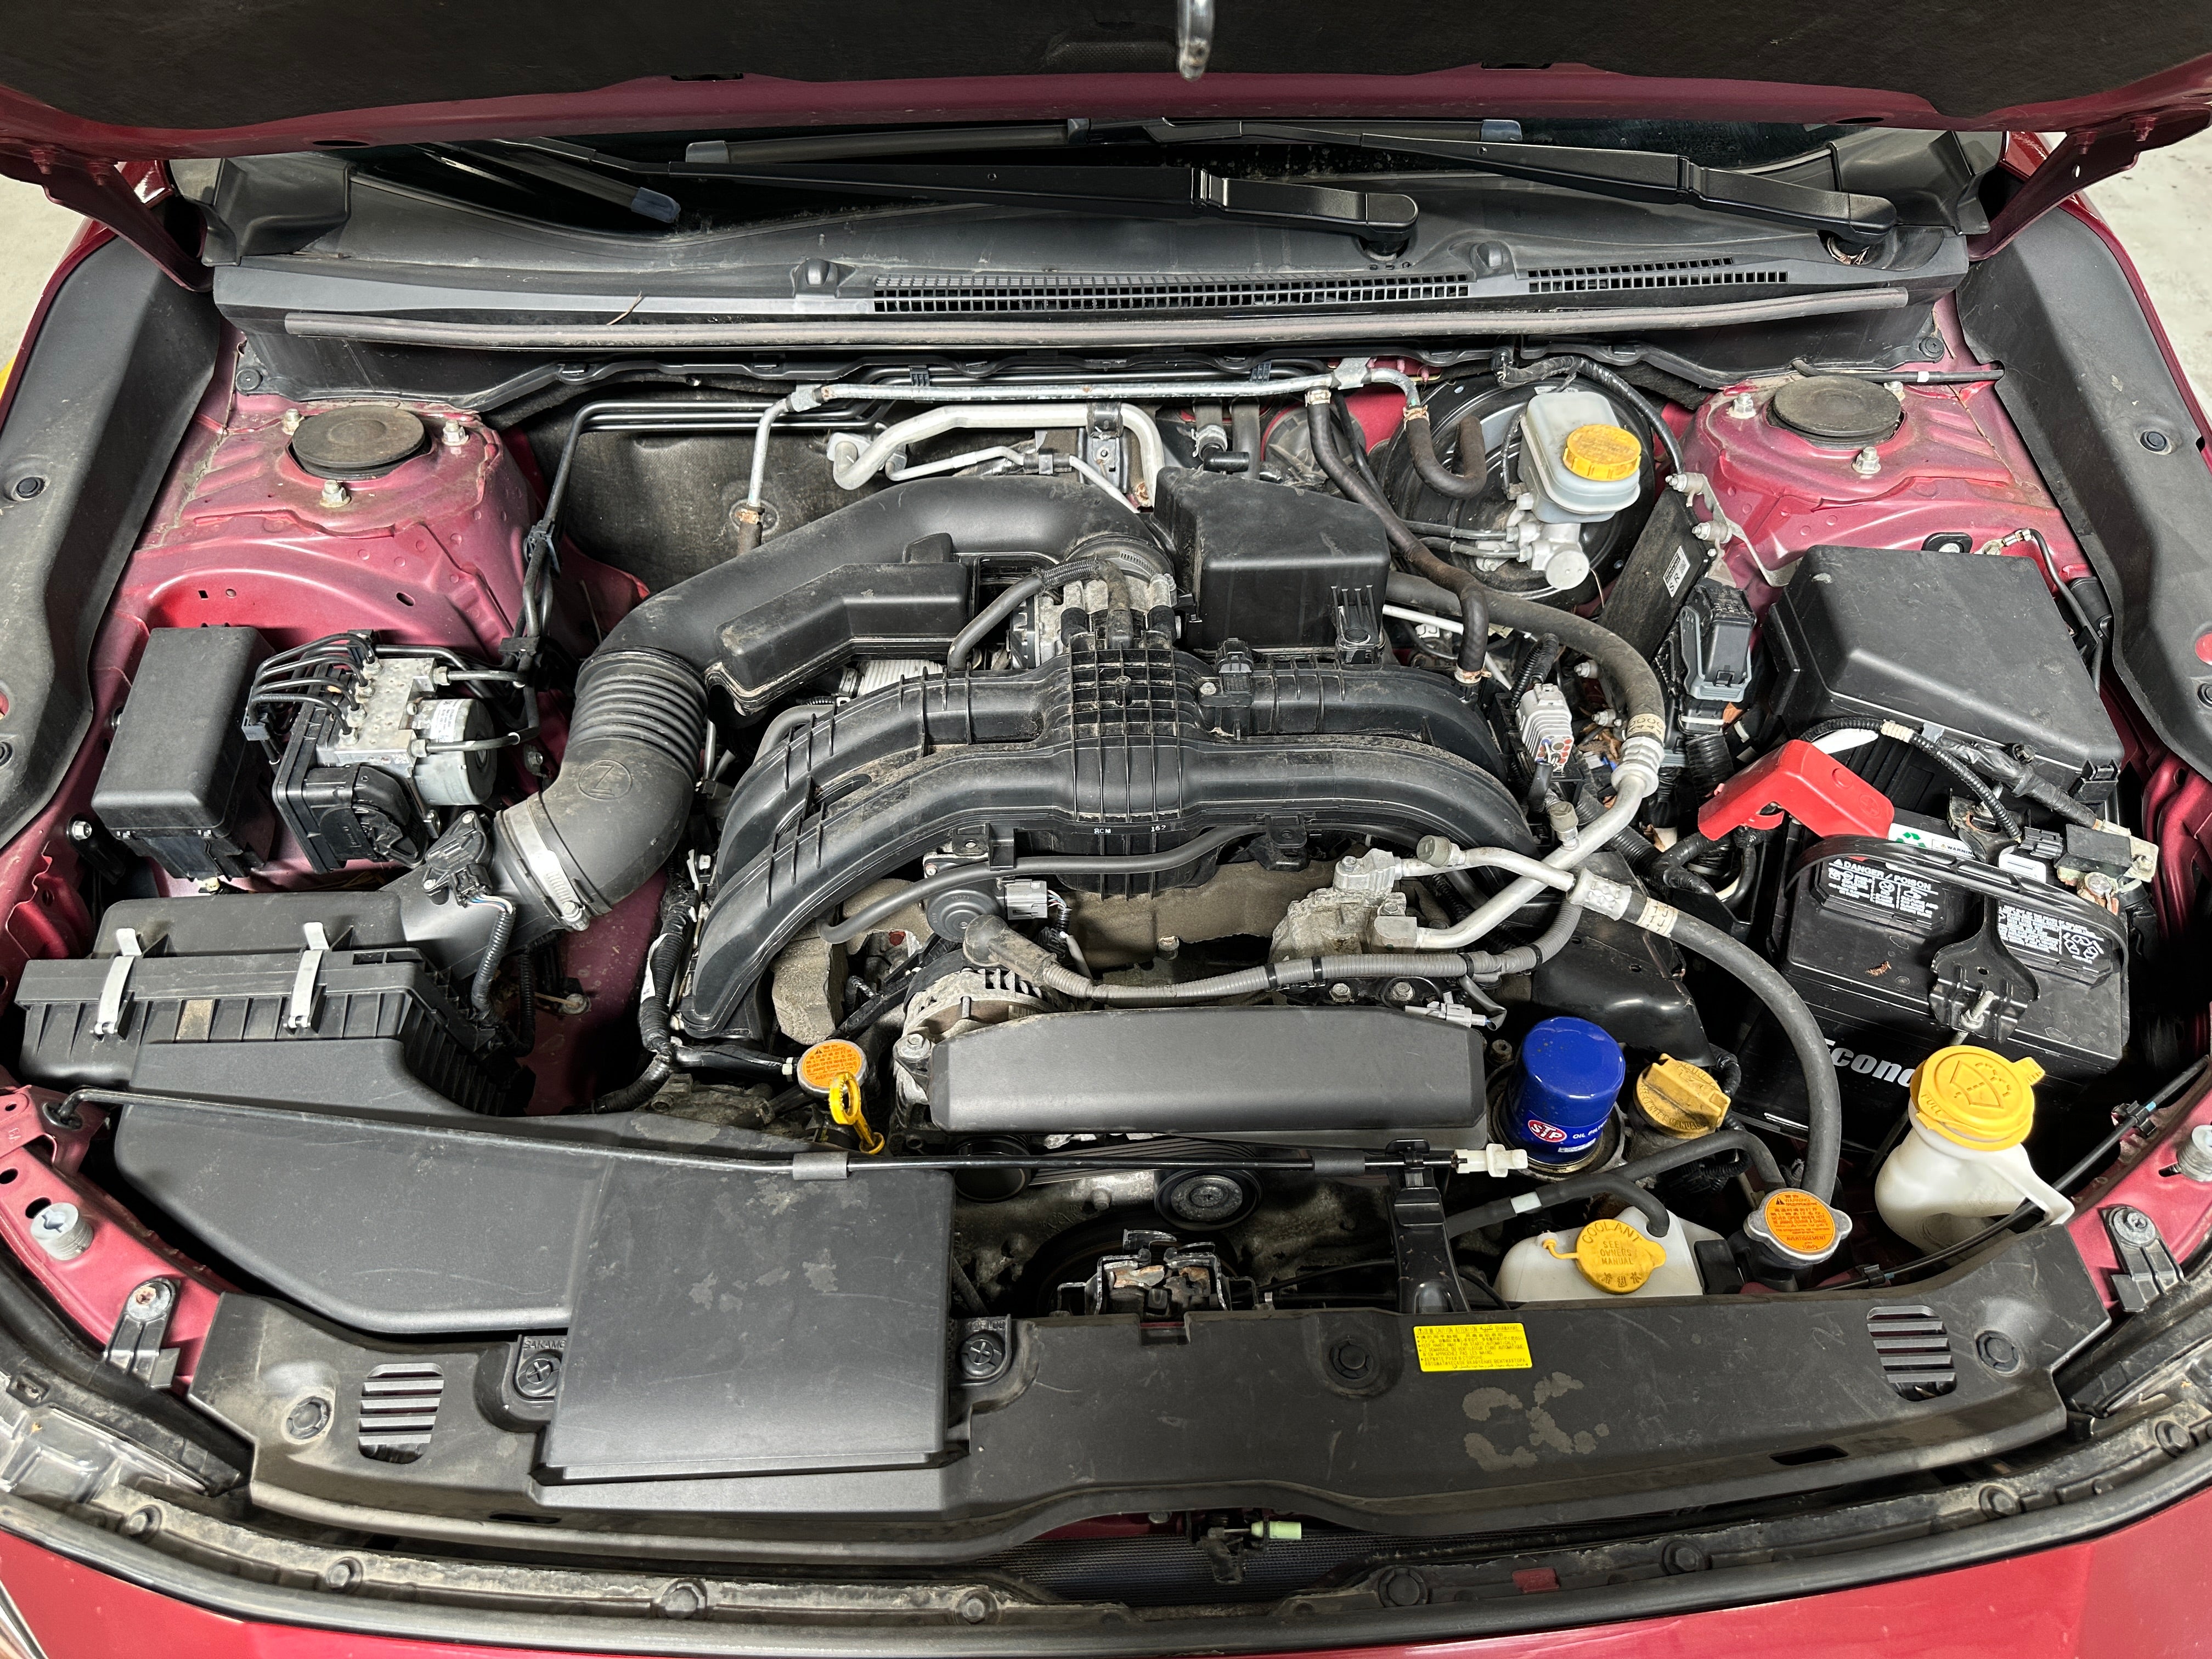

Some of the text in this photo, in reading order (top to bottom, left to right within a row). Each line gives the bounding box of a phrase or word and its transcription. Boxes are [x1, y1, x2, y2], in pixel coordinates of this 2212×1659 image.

[1948, 845, 1973, 855] WARNIN
[1843, 861, 1884, 879] DANGER
[1893, 874, 1932, 890] POISON
[1921, 1093, 1943, 1115] PULL
[1531, 1123, 1562, 1139] STP
[1669, 1118, 1700, 1130] MANUAL
[1582, 1221, 1643, 1244] COOLANT
[1600, 1249, 1632, 1257] OWNERS
[1601, 1257, 1634, 1265] MANUAL
